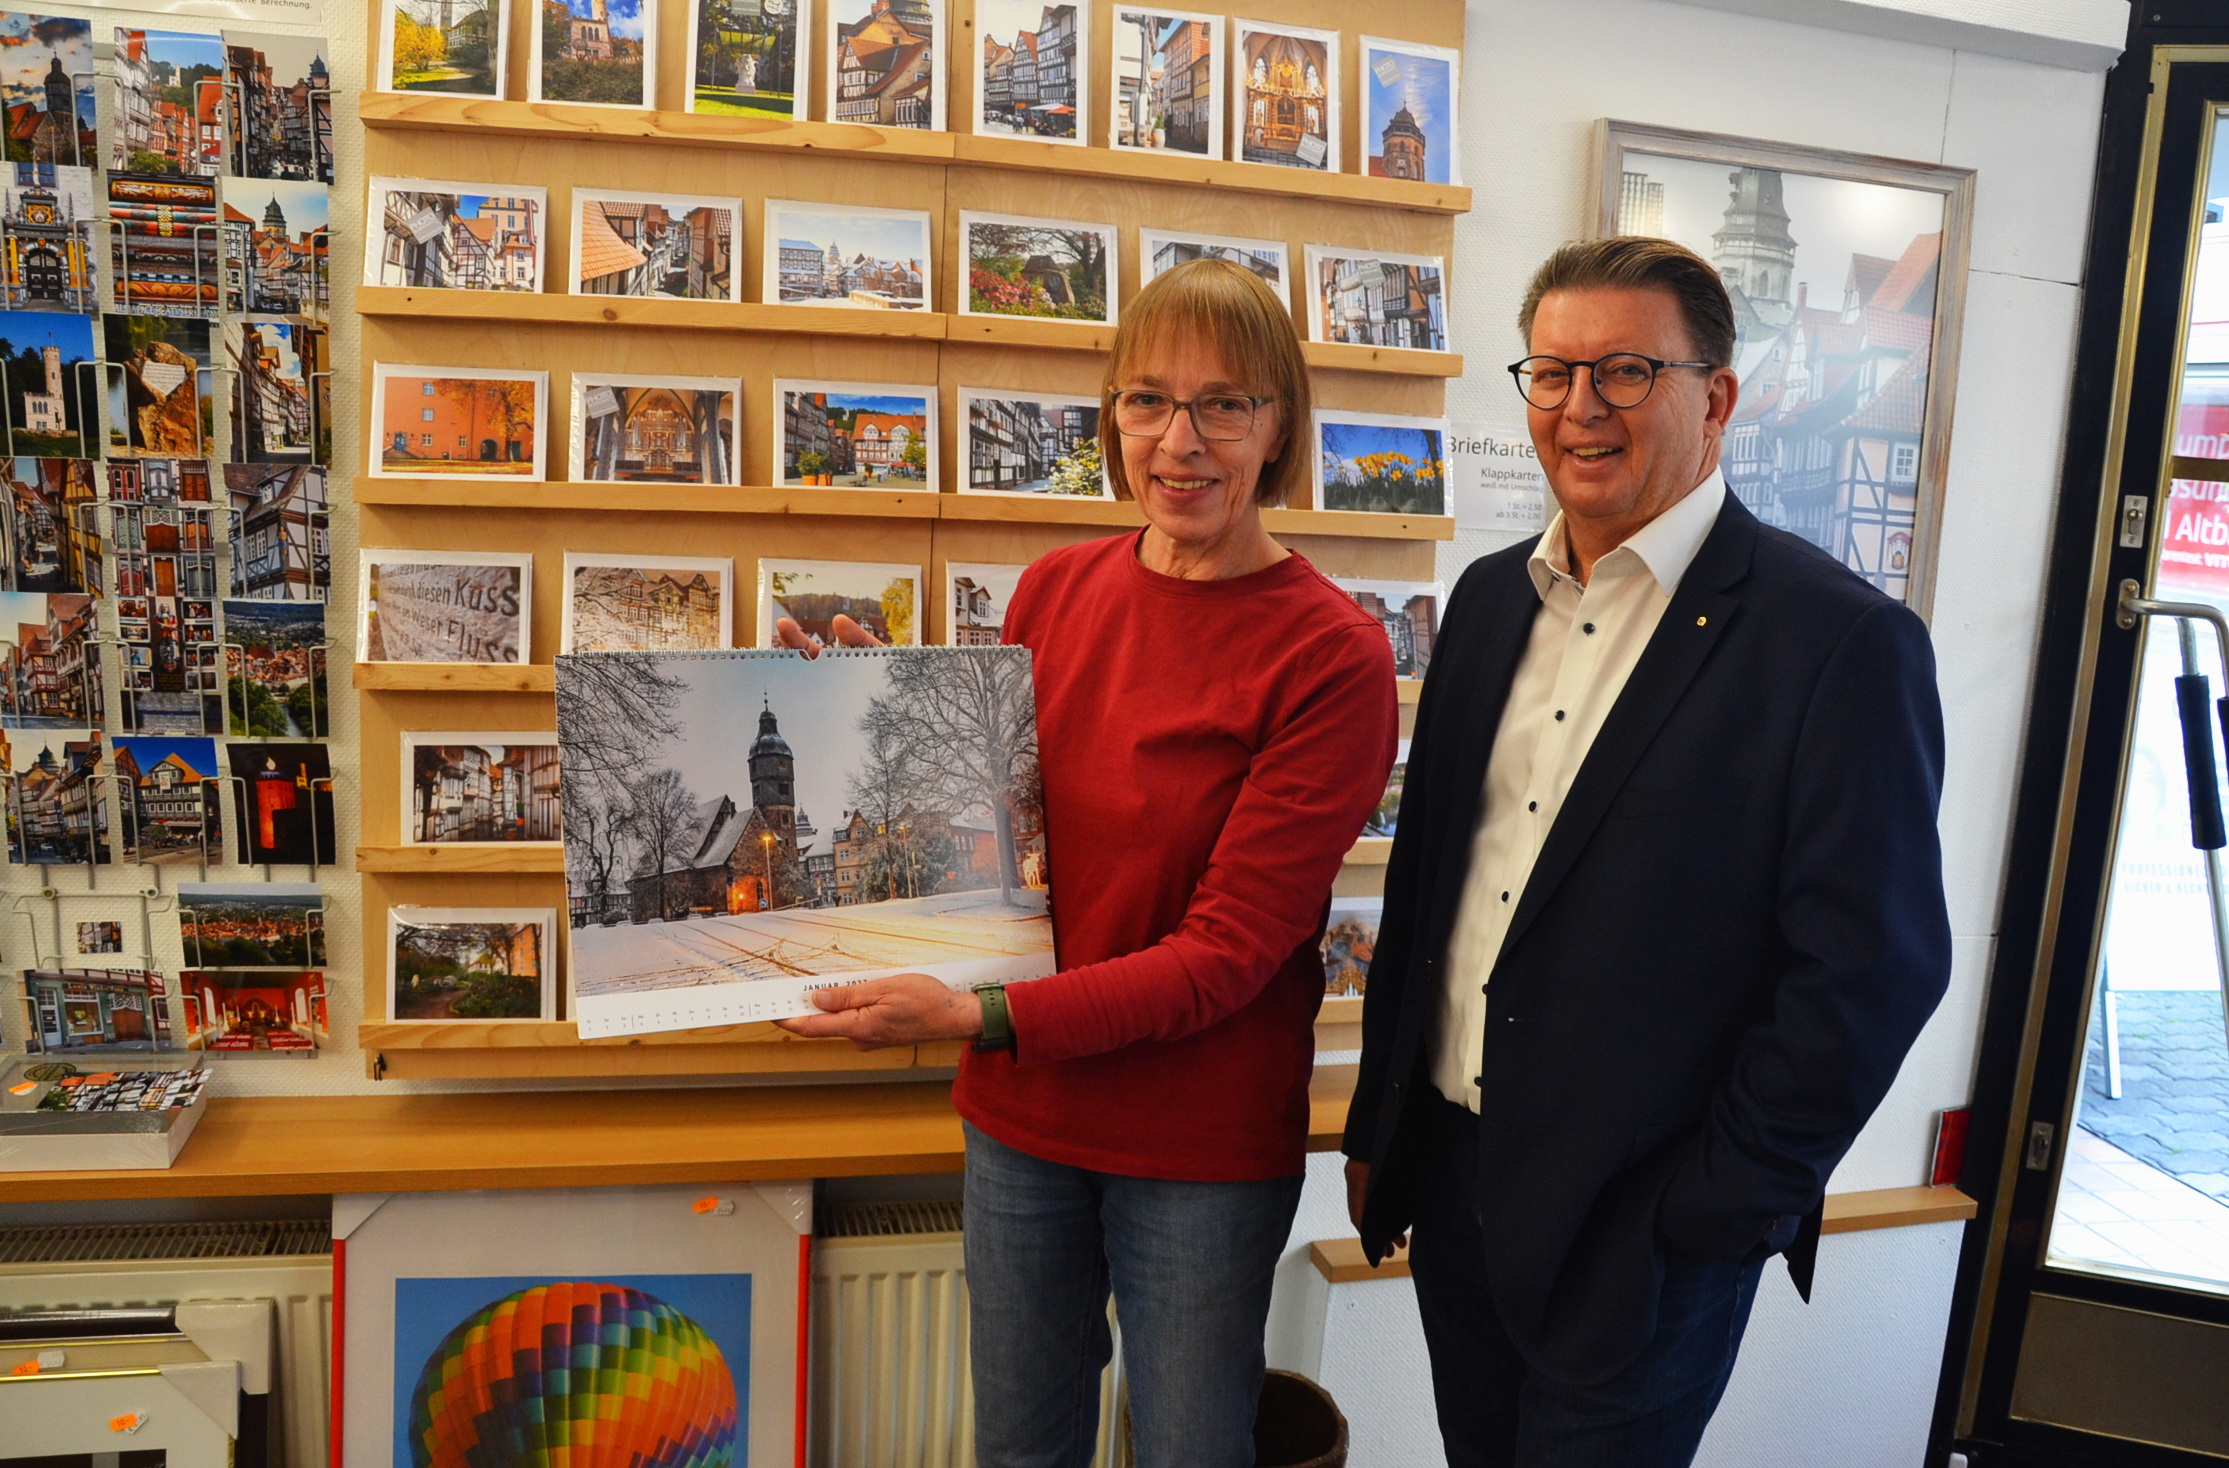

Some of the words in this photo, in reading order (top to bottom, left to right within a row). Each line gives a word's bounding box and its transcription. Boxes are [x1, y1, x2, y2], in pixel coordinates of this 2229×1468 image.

[1451, 436, 1537, 459] Briefkarte
[1481, 468, 1544, 481] Klappkarten
[2174, 511, 2229, 546] Altb
[416, 581, 451, 606] diesen
[455, 577, 519, 617] Kuss
[412, 608, 443, 636] Weser
